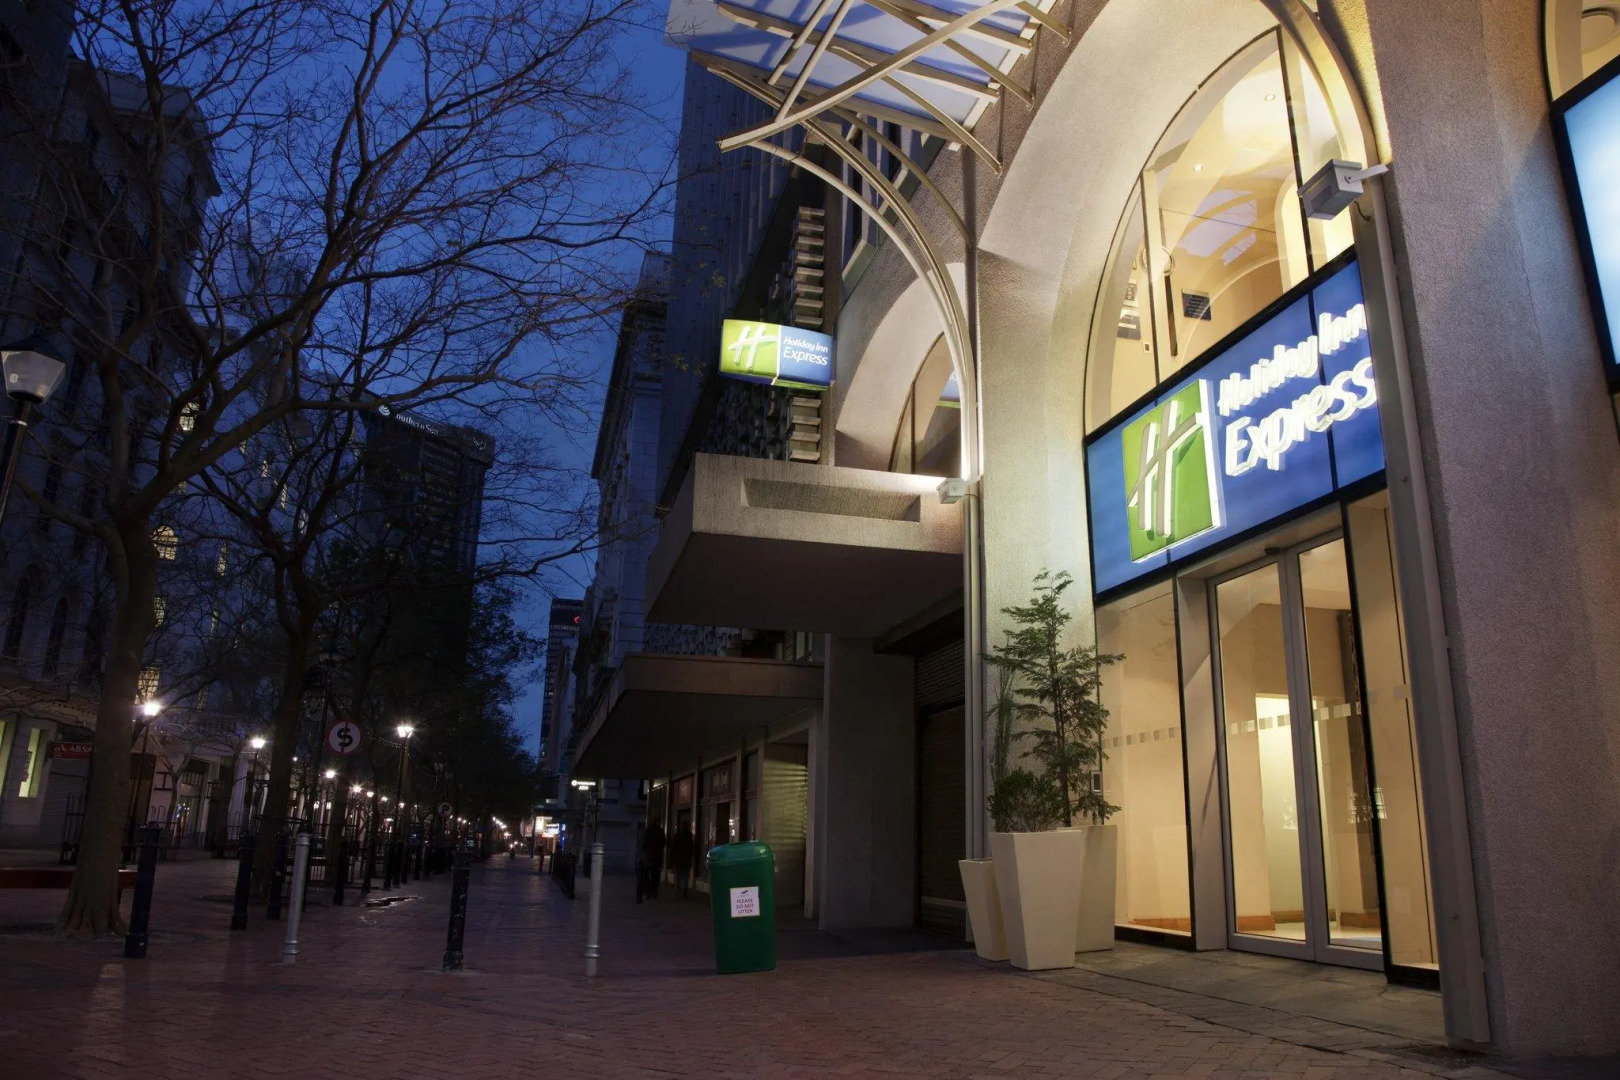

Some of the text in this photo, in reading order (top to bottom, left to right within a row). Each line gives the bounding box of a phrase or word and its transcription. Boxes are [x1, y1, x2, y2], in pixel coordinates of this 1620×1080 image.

[783, 336, 829, 353] Holiday Inn
[783, 346, 828, 366] Express
[1217, 303, 1367, 415] Holiday Inn
[1224, 356, 1377, 477] Express
